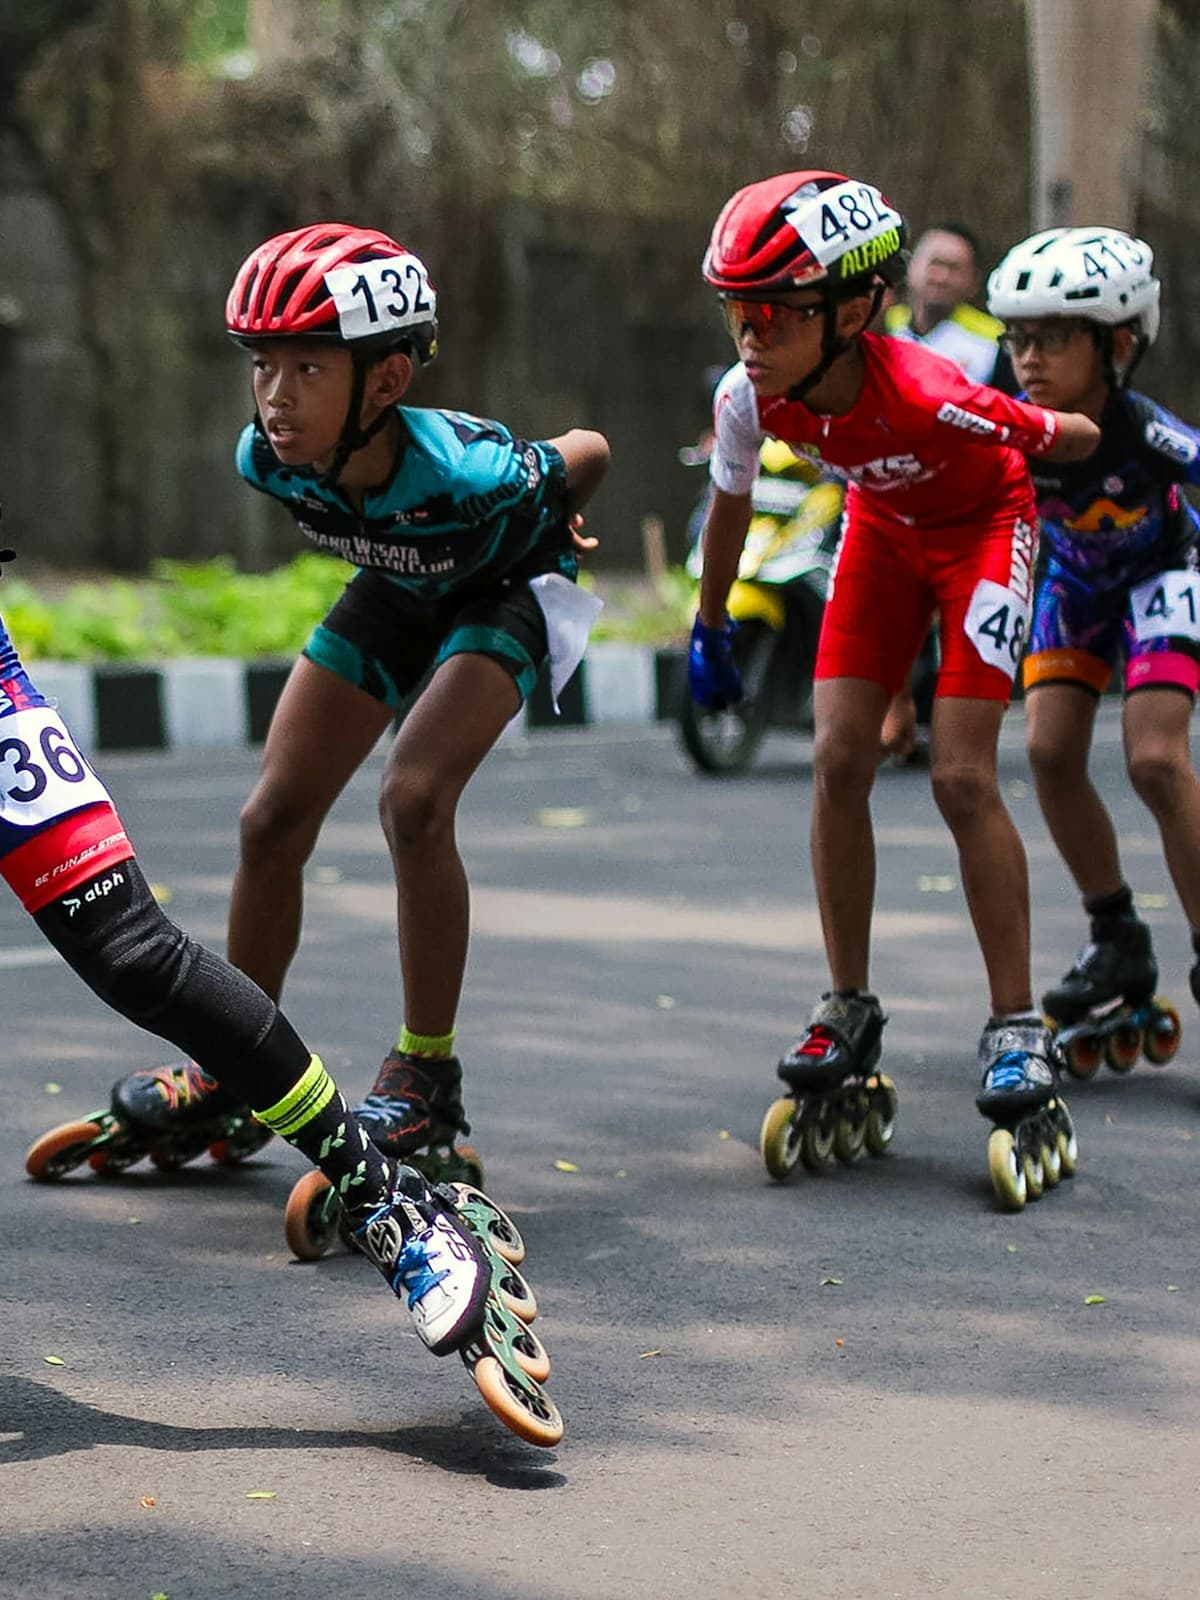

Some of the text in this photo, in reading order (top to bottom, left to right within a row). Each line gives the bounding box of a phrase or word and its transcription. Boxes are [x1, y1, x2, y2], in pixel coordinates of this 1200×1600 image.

[822, 187, 890, 241] 482
[351, 264, 430, 323] 132
[1145, 585, 1196, 624] 41
[978, 604, 1025, 664] 48
[35, 872, 50, 888] BE
[84, 873, 125, 902] alph
